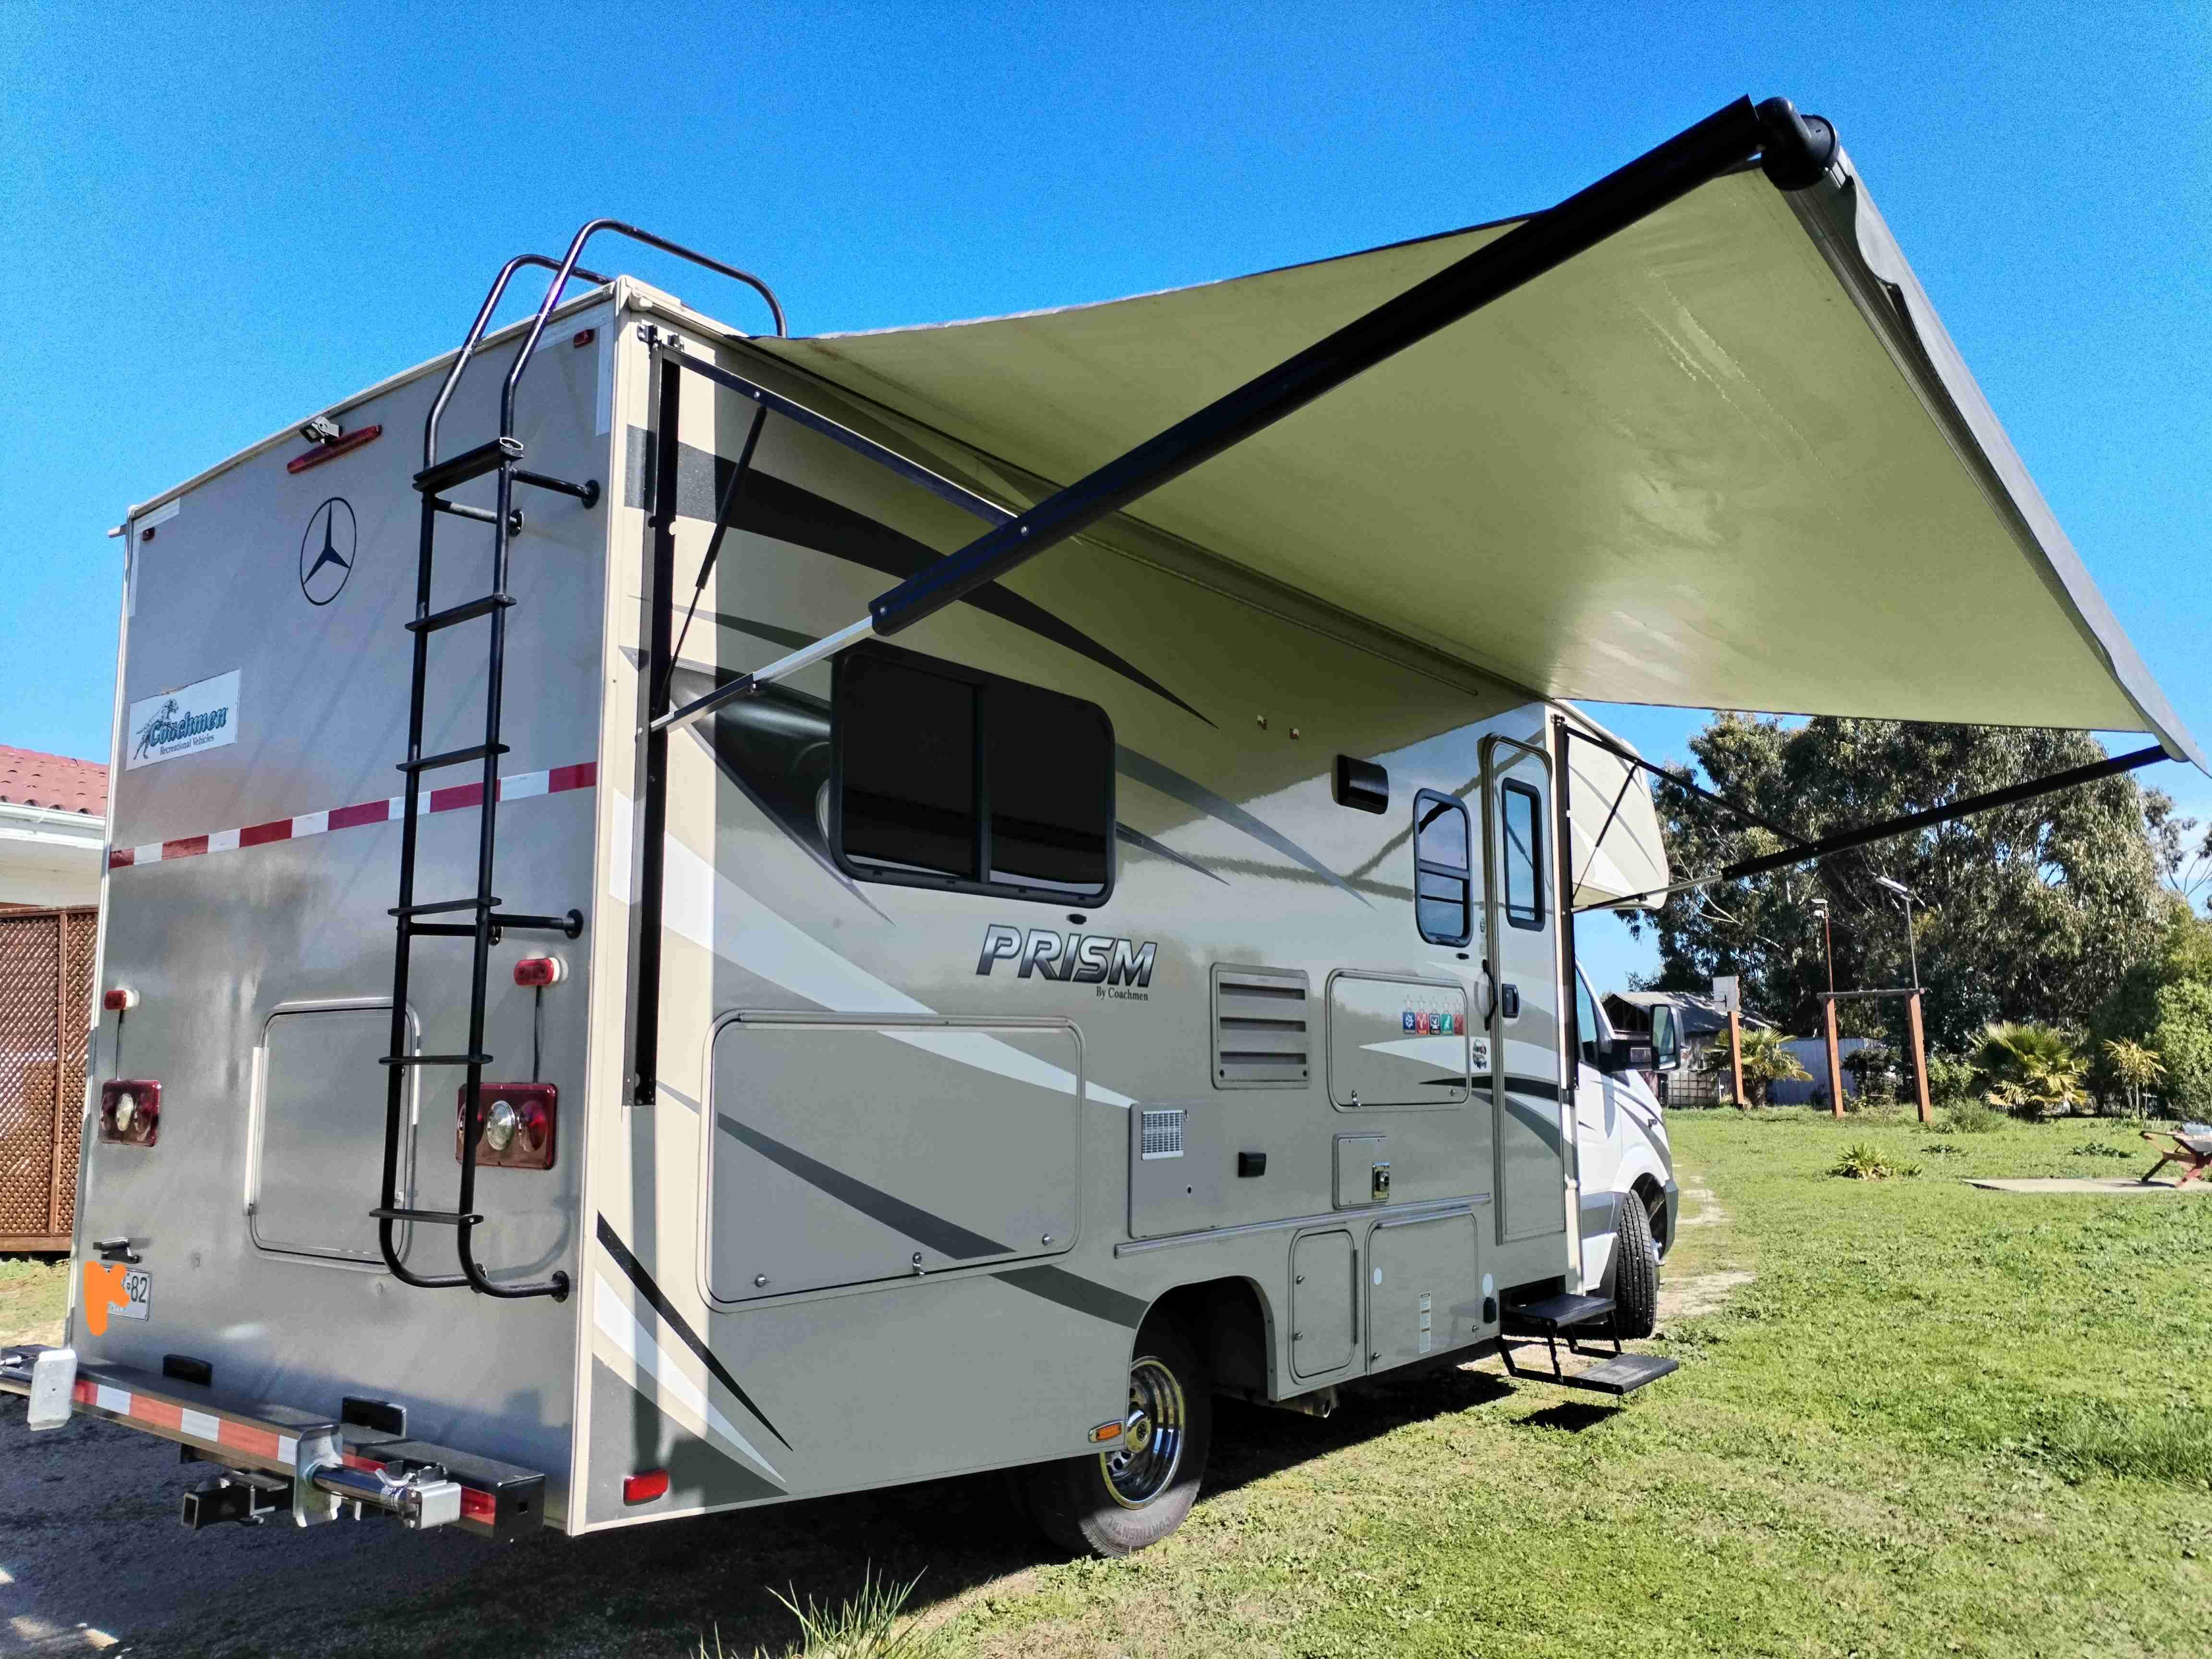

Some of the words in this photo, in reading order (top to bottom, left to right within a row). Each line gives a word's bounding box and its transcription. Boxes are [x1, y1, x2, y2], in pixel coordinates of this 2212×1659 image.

[149, 707, 228, 747] Coachmen
[160, 738, 192, 755] Recreational
[192, 733, 215, 745] Vehicles
[975, 923, 1158, 988] PRISM
[1096, 986, 1106, 1001] By
[1108, 986, 1149, 1001] Coachmen
[1107, 1516, 1172, 1540] CONTINENTAL
